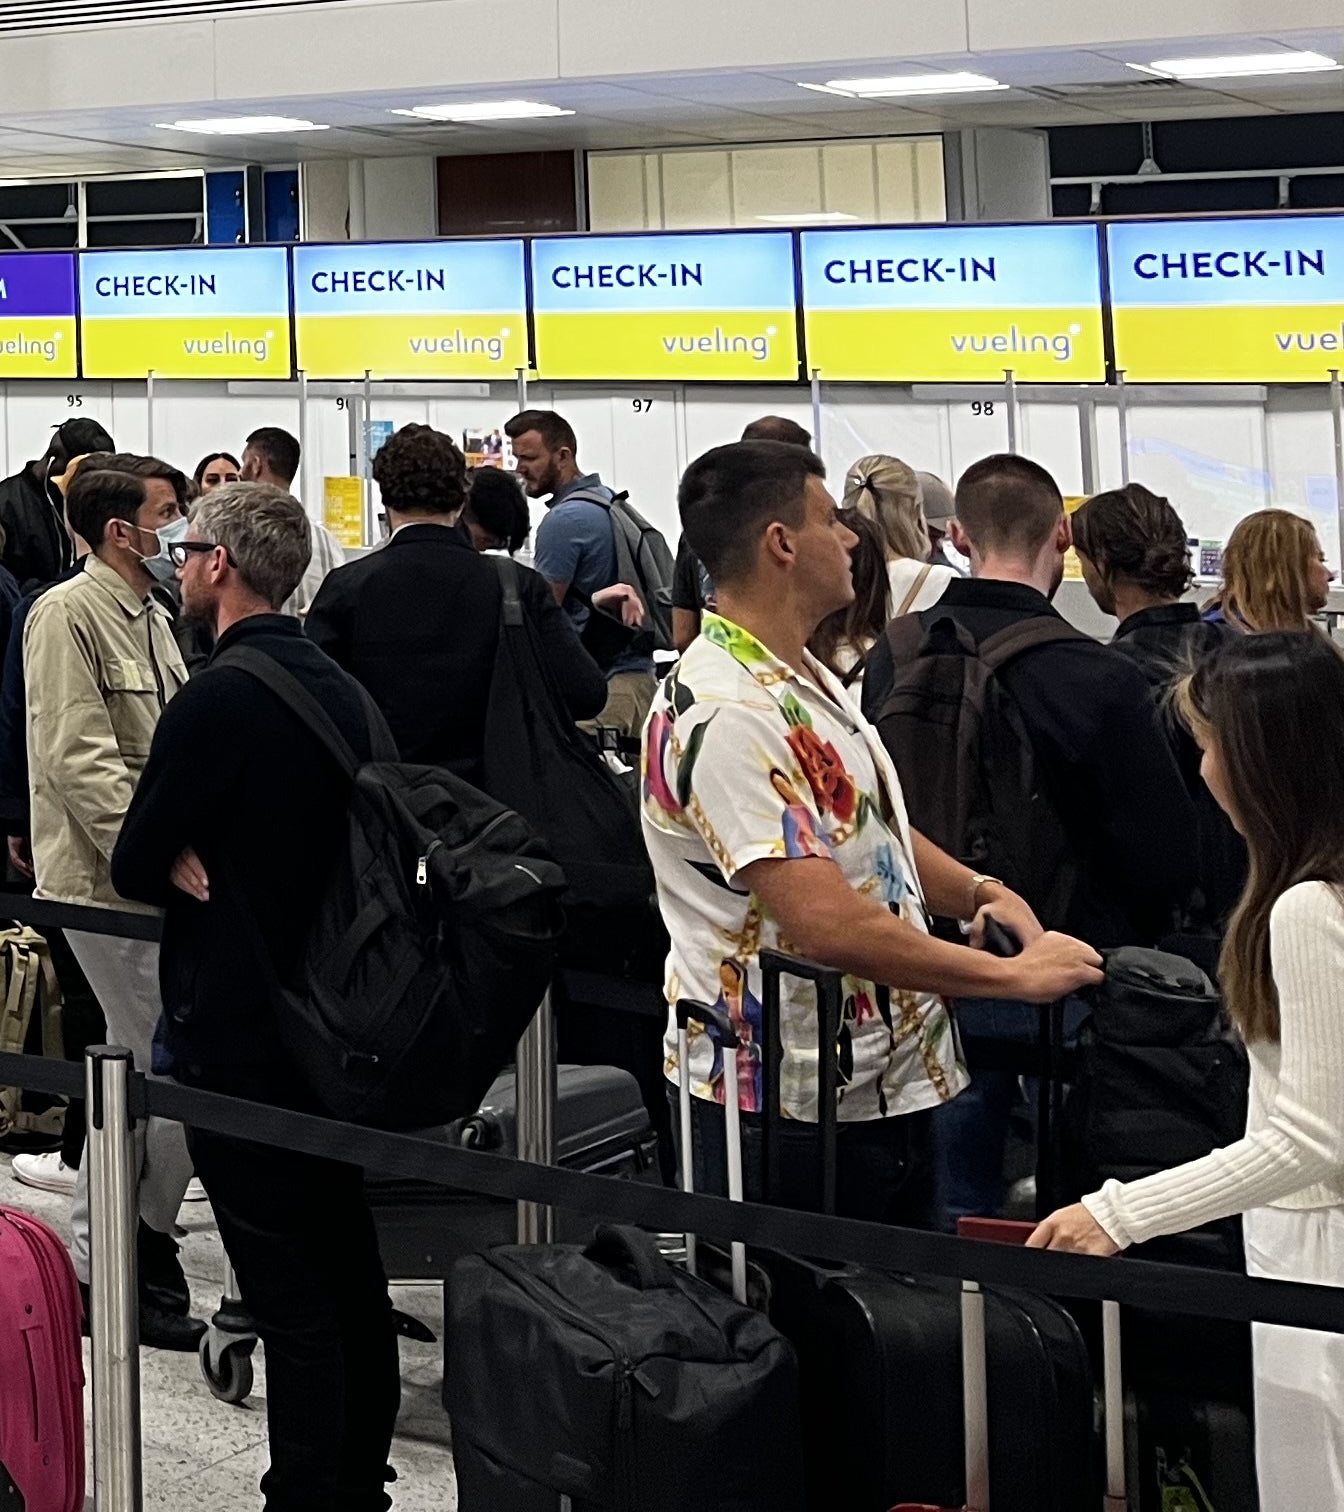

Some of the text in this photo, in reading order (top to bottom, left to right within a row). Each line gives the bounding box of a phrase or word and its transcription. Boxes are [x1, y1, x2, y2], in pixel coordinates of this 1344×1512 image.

[552, 264, 702, 288] CHECK-IN
[824, 257, 996, 283] CHECK-IN
[1133, 250, 1325, 279] CHECK-IN
[95, 274, 216, 297] CHECK-IN
[312, 269, 445, 292] CHECK-IN
[184, 331, 267, 361] vueling
[410, 329, 502, 360] vueling
[663, 327, 768, 361] vueling
[951, 325, 1071, 361] vueling
[67, 395, 83, 408] 95
[632, 399, 653, 413] 97
[972, 401, 994, 416] 98
